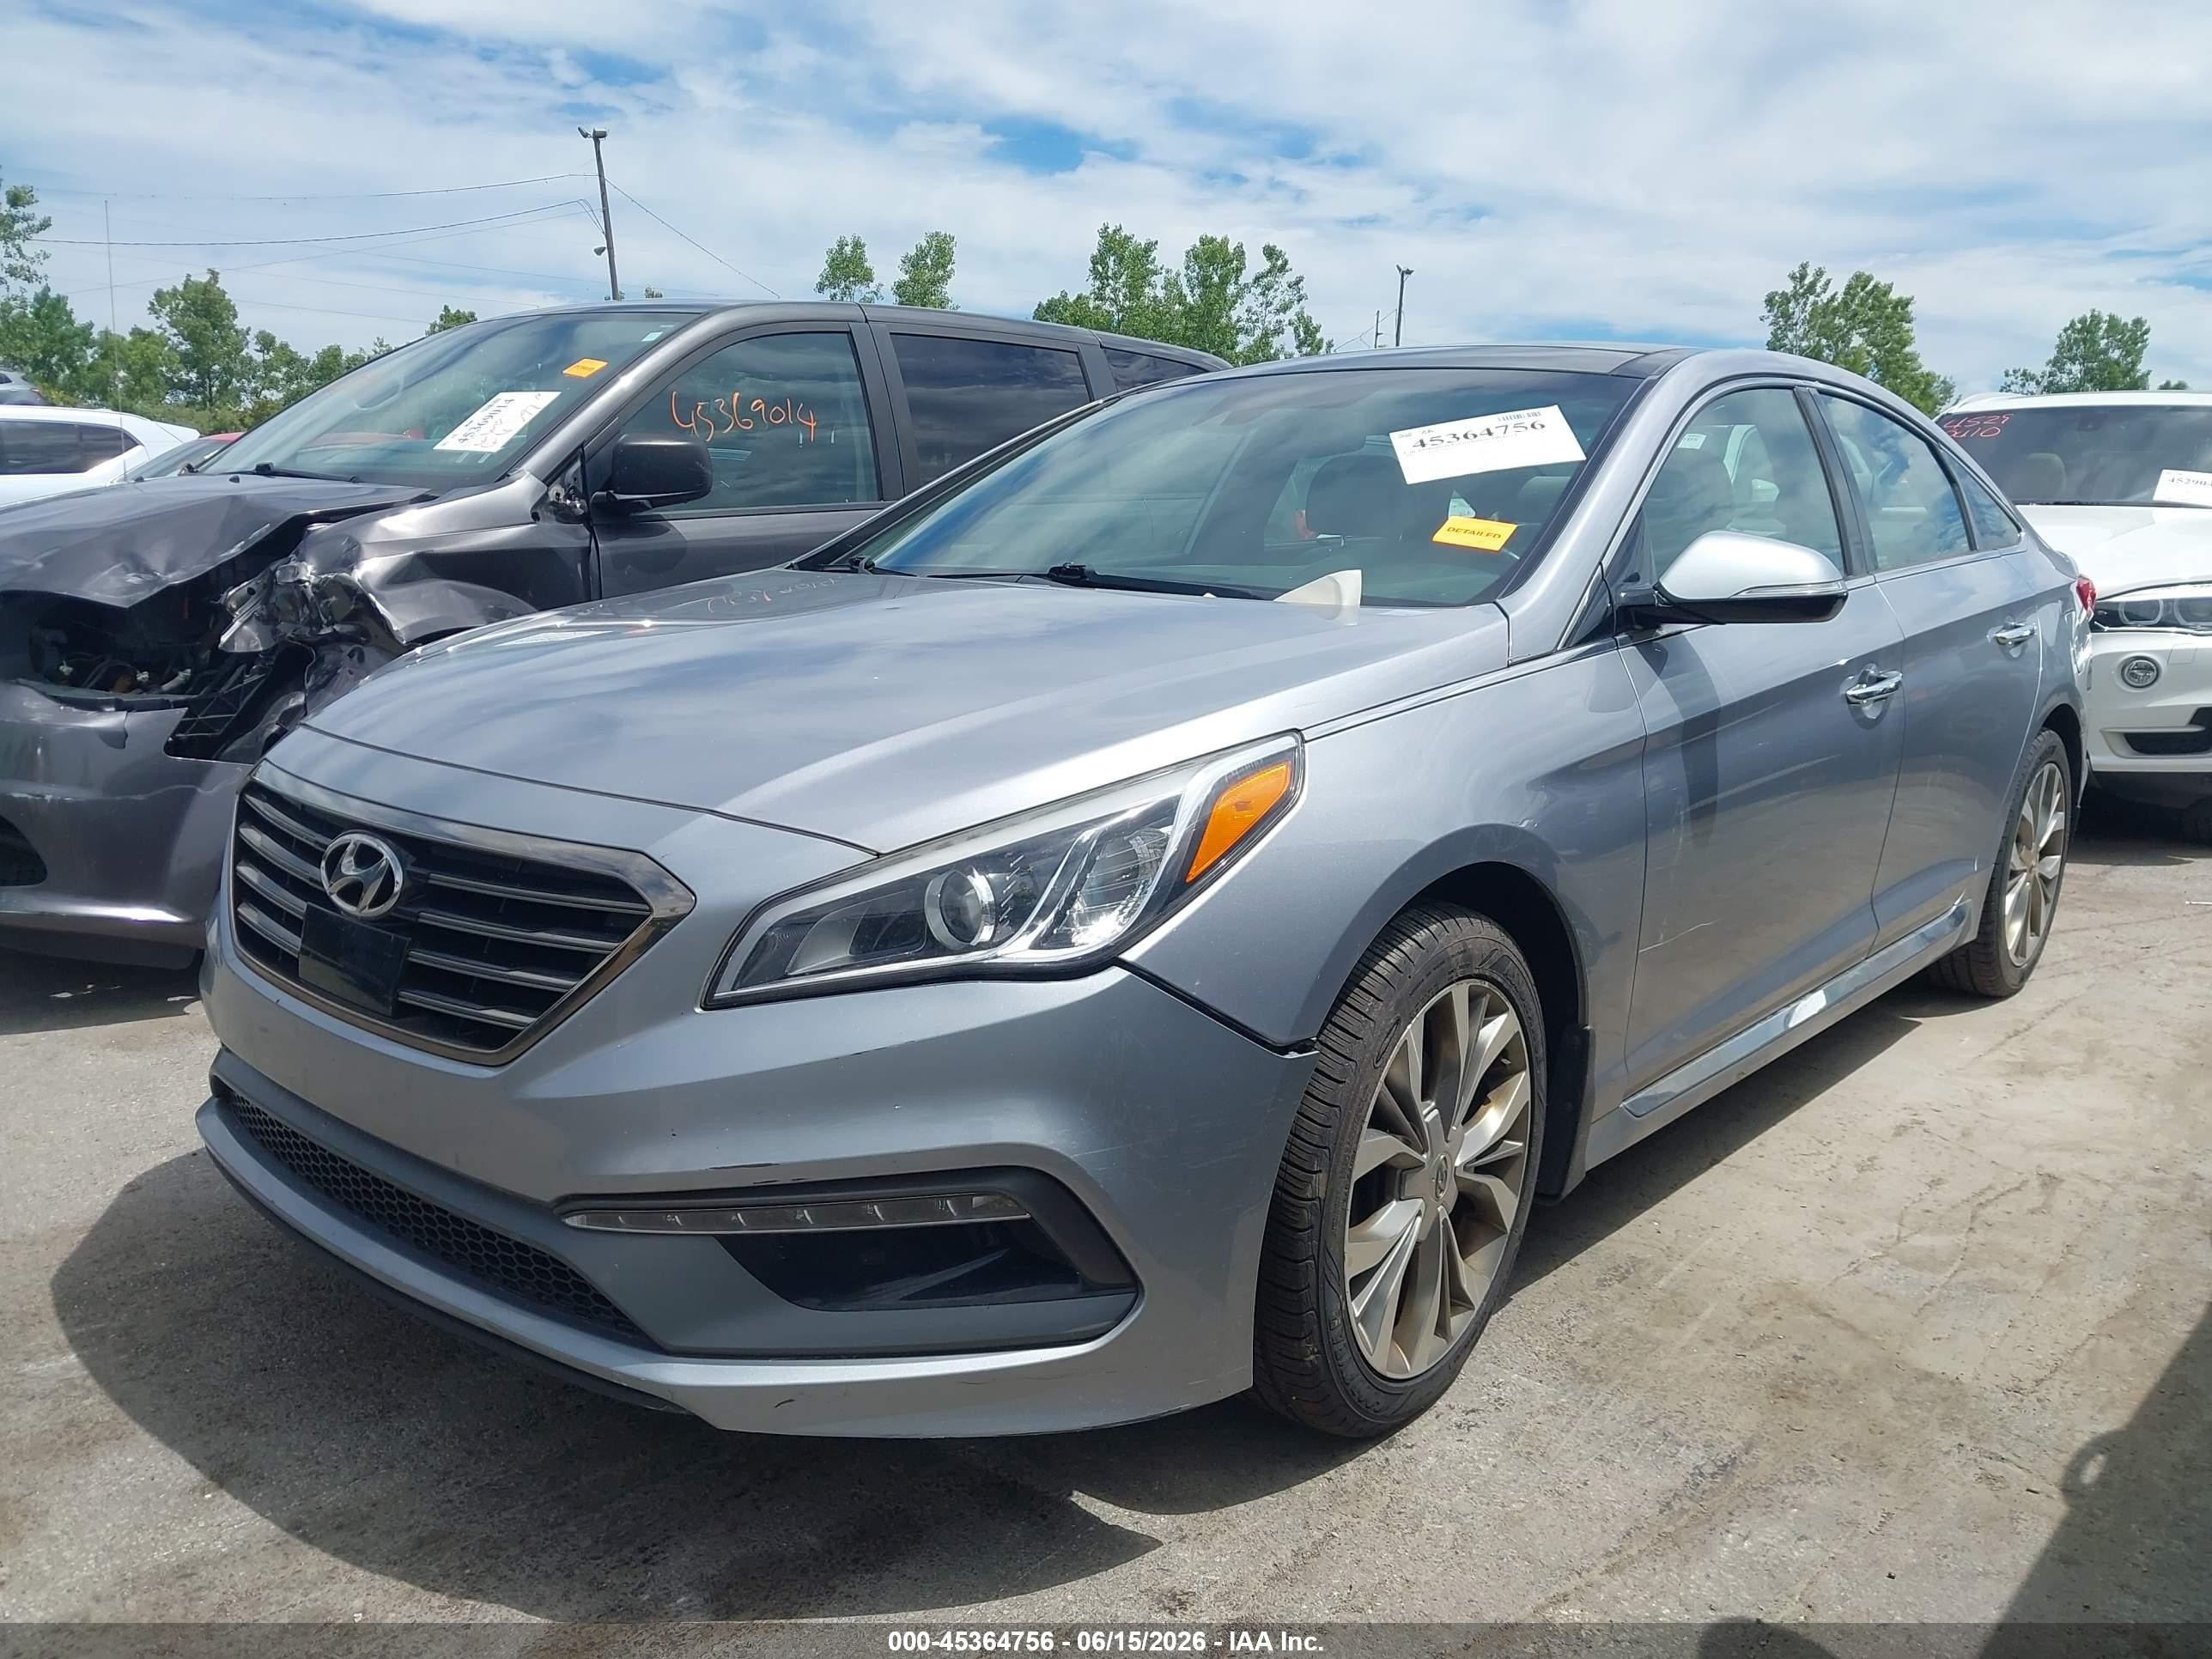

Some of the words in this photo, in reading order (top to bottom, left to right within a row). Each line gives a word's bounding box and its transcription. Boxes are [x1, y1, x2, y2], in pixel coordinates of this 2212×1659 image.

[672, 392, 817, 442] 45369014
[1412, 420, 1546, 448] 45364756
[1446, 526, 1502, 539] DETAILED
